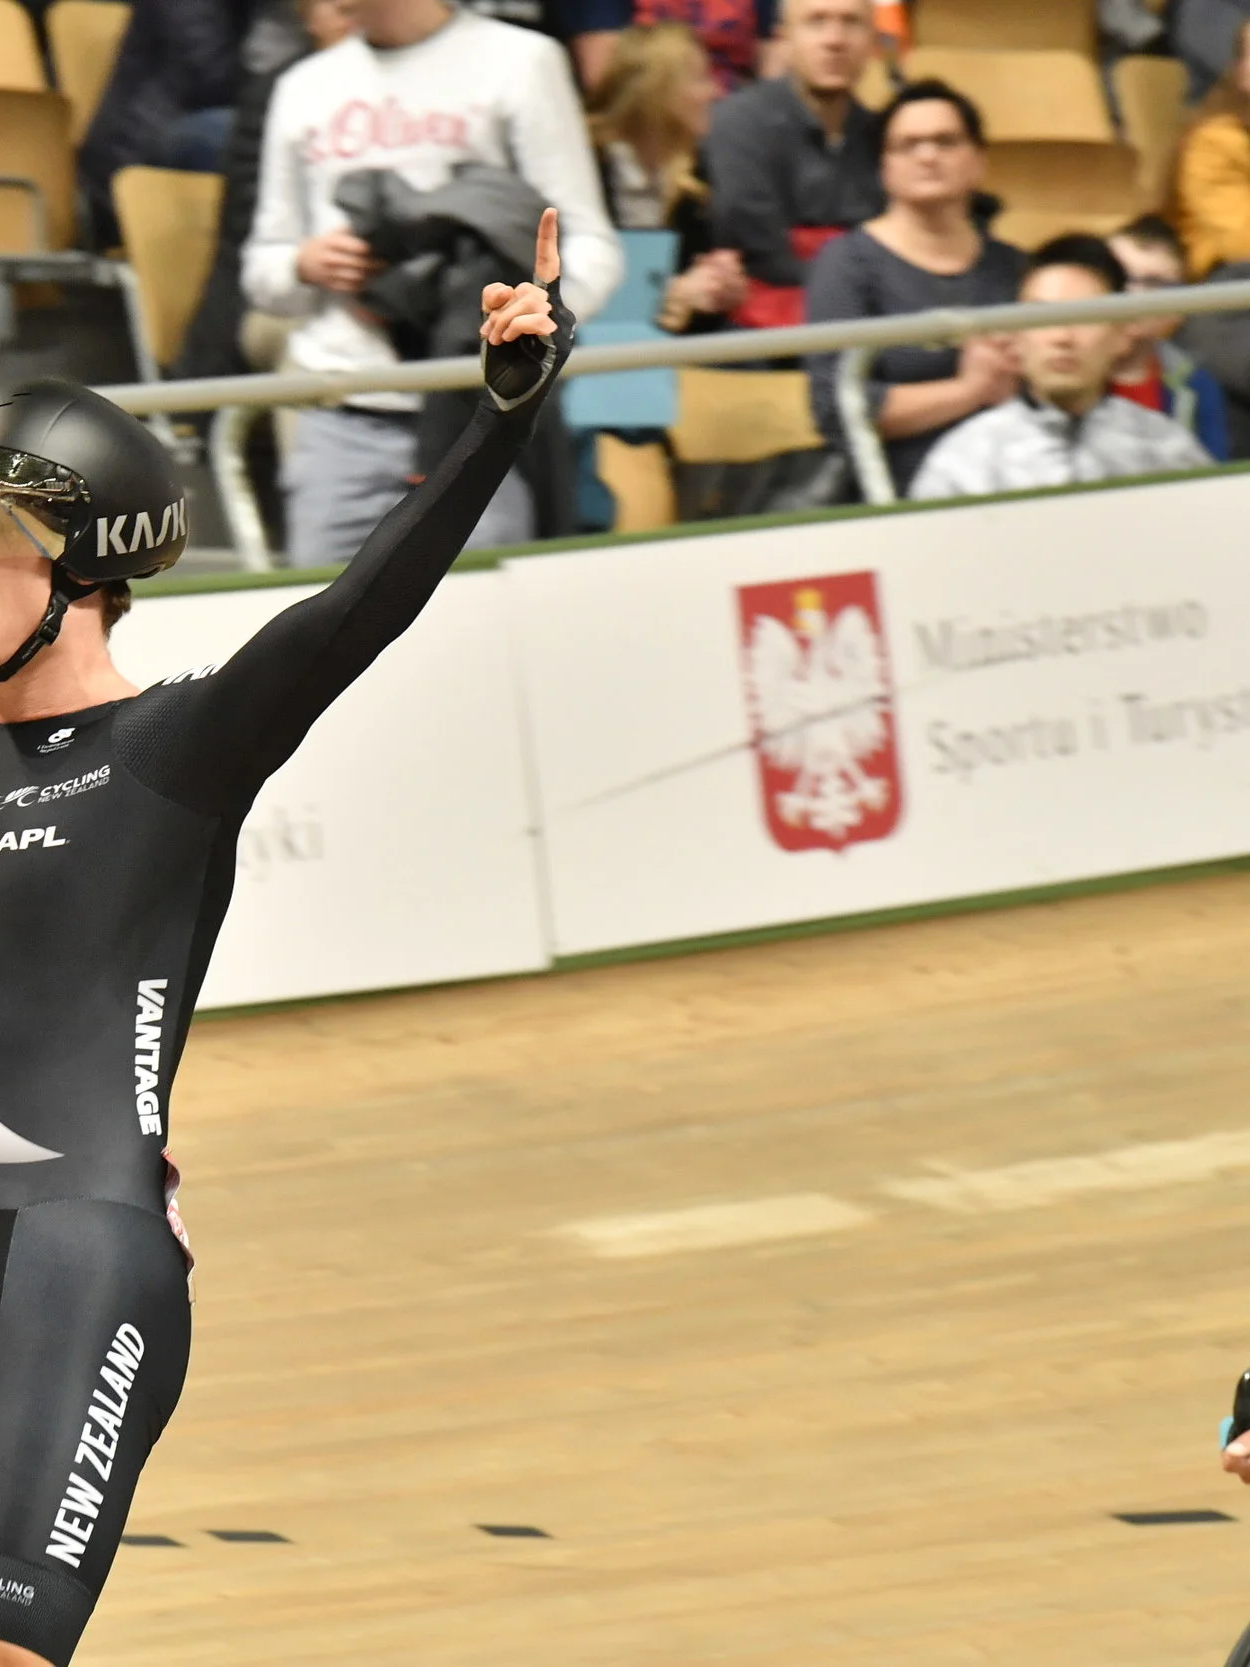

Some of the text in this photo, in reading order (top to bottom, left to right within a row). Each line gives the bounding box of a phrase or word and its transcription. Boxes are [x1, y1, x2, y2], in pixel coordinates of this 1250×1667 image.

[37, 777, 110, 804] NEW ZEALAND
[40, 764, 110, 797] CYCLING
[134, 979, 168, 1136] VANTAGE
[45, 1322, 145, 1569] NEW ZEALAND
